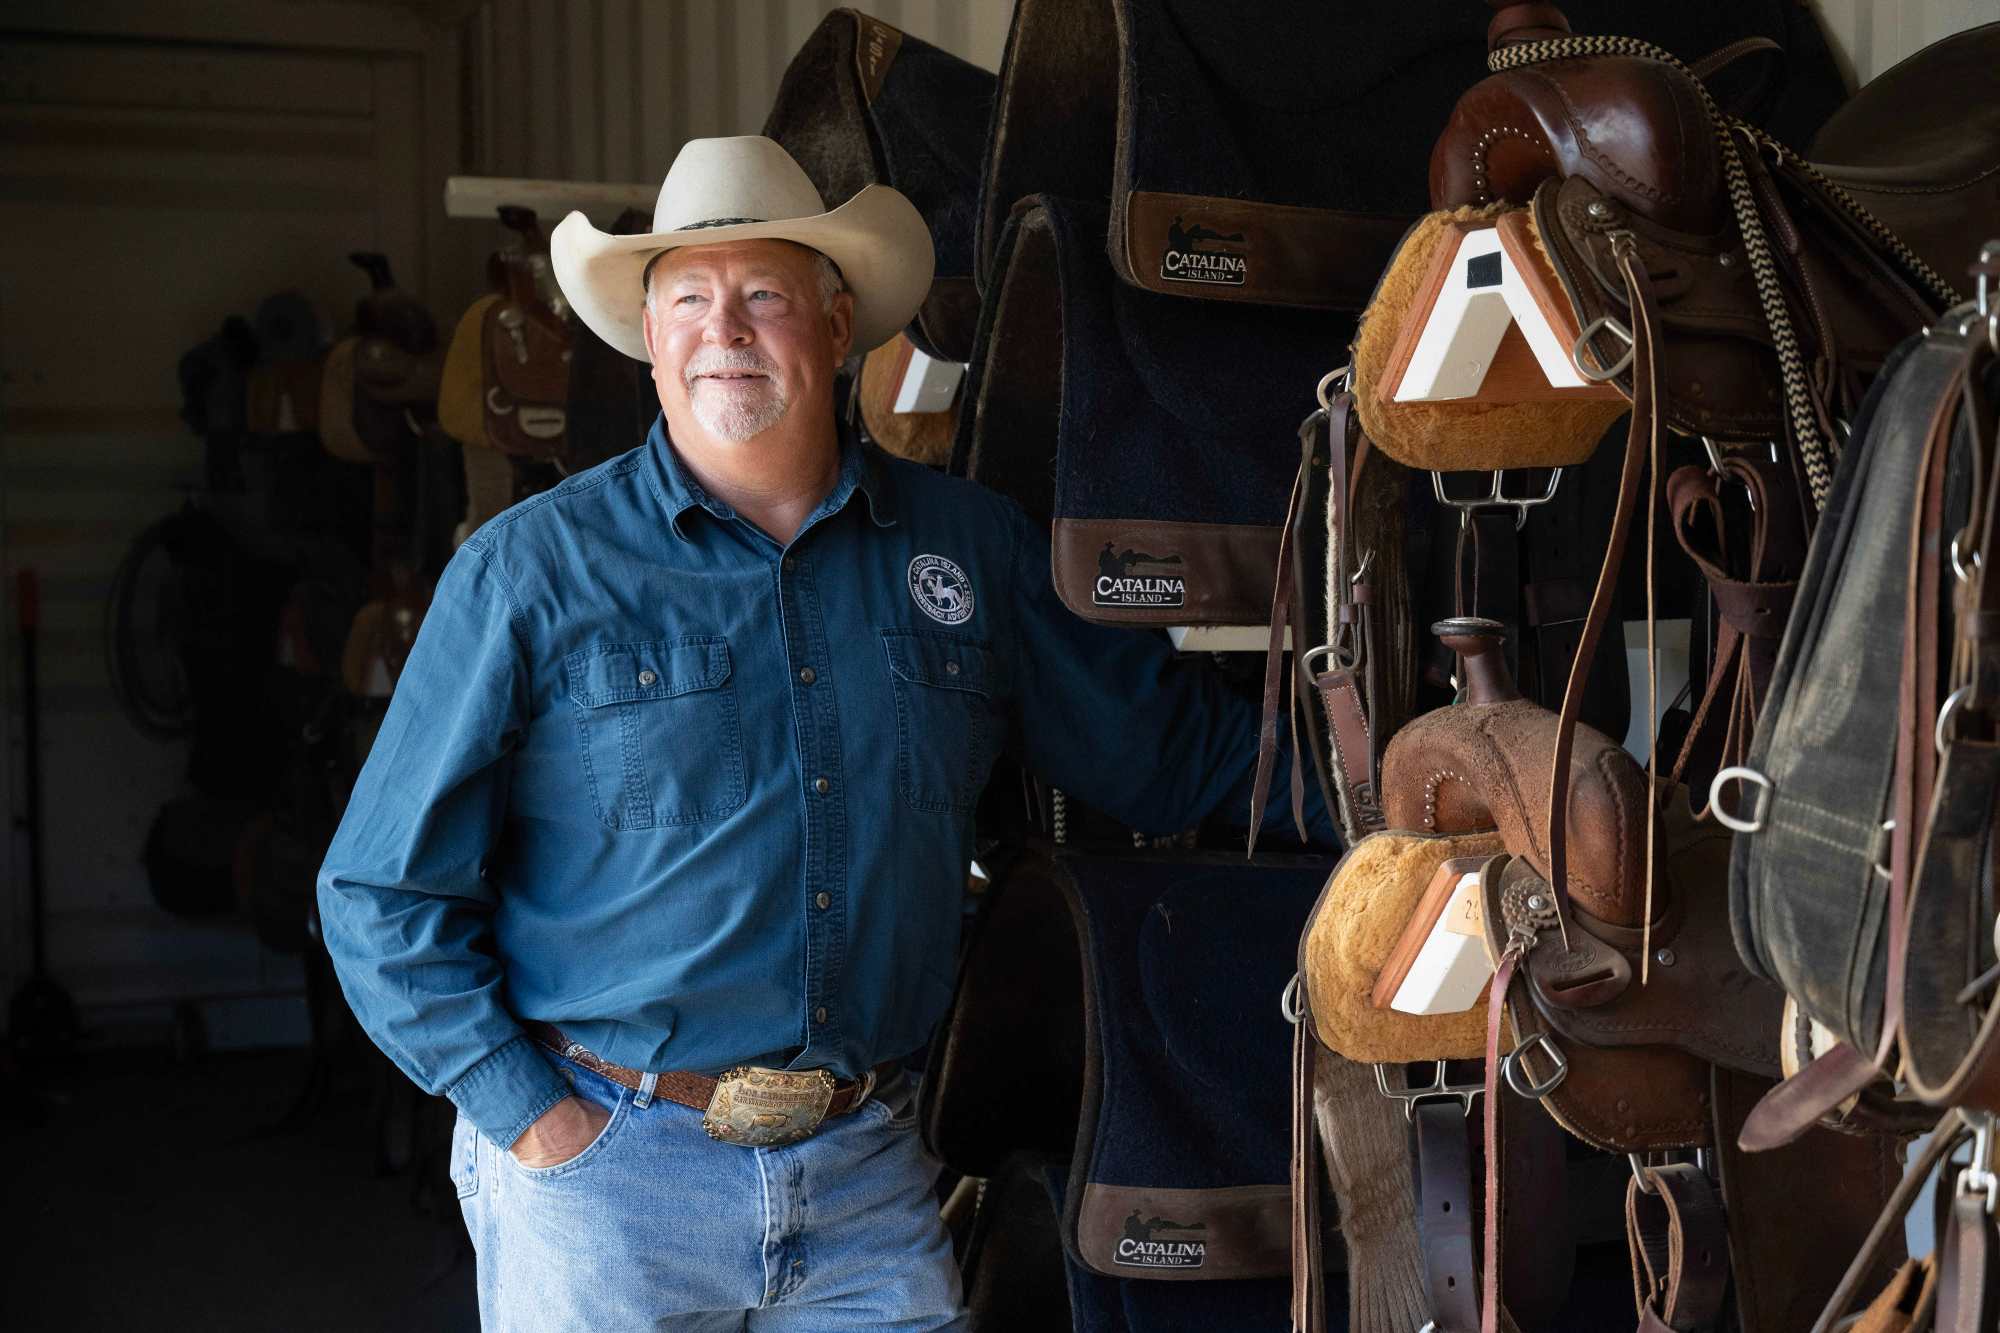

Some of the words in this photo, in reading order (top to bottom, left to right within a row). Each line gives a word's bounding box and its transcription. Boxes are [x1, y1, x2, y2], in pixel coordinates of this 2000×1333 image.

[1166, 250, 1247, 272] CATALINA
[1187, 269, 1225, 280] ISLAND
[912, 557, 939, 575] CATALINA
[941, 560, 965, 583] ISLAND
[1097, 576, 1185, 595] CATALINA
[1121, 593, 1162, 603] ISLAND
[1119, 1238, 1205, 1256] CATALINA
[1142, 1255, 1182, 1265] ISLAND
